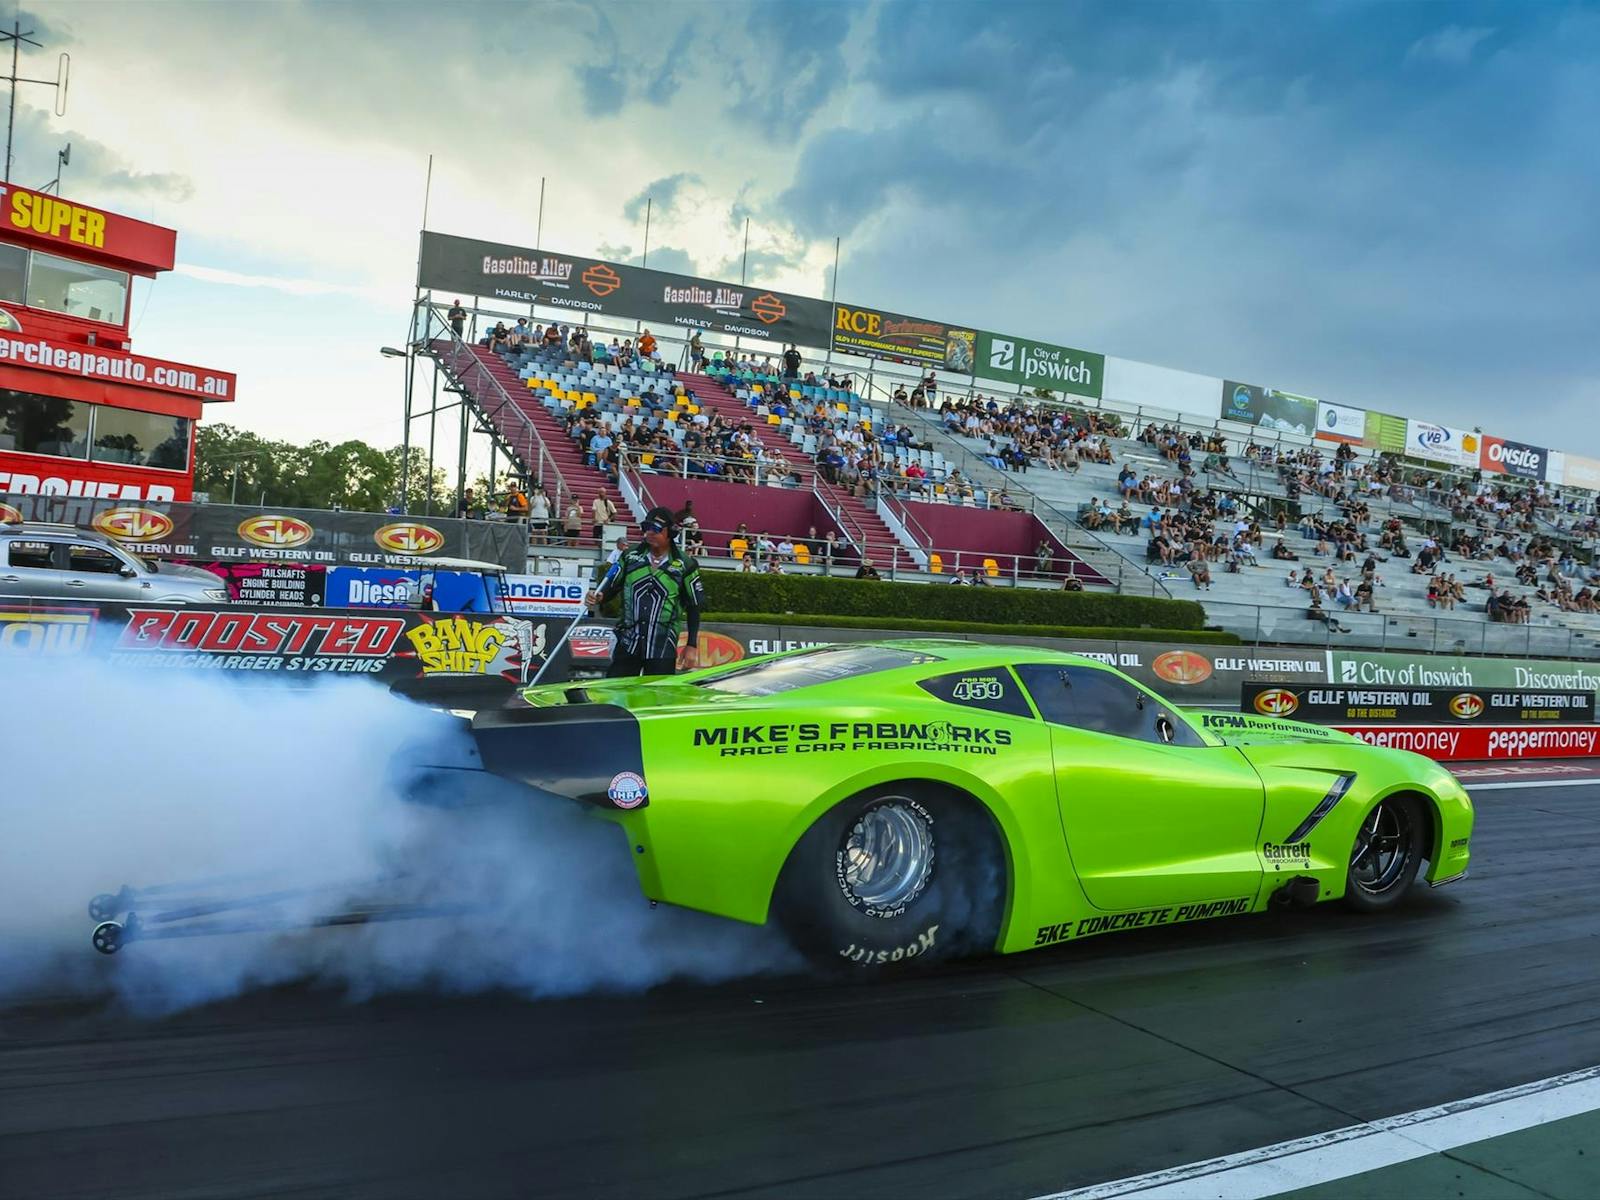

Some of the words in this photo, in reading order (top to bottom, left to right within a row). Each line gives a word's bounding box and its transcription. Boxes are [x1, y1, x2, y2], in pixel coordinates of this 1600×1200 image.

[10, 191, 106, 249] SUPER
[482, 256, 538, 275] Gasoline
[540, 258, 573, 280] Alley
[495, 288, 538, 301] HARLEY
[551, 297, 603, 311] DAVIDSON
[663, 286, 711, 304] Gasoline
[714, 288, 744, 309] Alley
[674, 316, 713, 328] HARLEY
[724, 324, 770, 338] DAVIDSON
[836, 307, 881, 336] RCE
[1033, 347, 1049, 361] City
[1051, 351, 1061, 361] of
[1020, 347, 1091, 385] Ipswich
[174, 544, 198, 556] OIL
[211, 546, 246, 558] GULF
[249, 548, 312, 560] WESTERN
[315, 551, 337, 562] OIL
[349, 552, 382, 564] GULF
[261, 568, 306, 579] TAILSHAFTS
[242, 578, 270, 589] ENGINE
[271, 580, 306, 590] BUILDING
[239, 589, 276, 600] CYLINDER
[279, 591, 305, 601] HEADS
[117, 608, 407, 657] BOOSTED
[406, 619, 504, 652] BANG
[285, 656, 387, 673] SYSTEMS
[421, 650, 496, 674] SHIFT
[1119, 653, 1144, 667] OIL
[1214, 657, 1246, 671] GULF
[1248, 659, 1306, 673] WESTERN
[1306, 661, 1324, 674] OIL
[1360, 661, 1396, 684] City
[1398, 664, 1416, 684] of
[1419, 664, 1473, 686] Ipswich
[952, 682, 1003, 701] 459
[1308, 690, 1345, 705] GULF
[1347, 691, 1409, 705] WESTERN
[1411, 692, 1433, 706] OIL
[1490, 694, 1520, 707] GULF
[1521, 695, 1570, 708] WESTERN
[1571, 696, 1589, 708] OIL
[693, 723, 821, 747] MIKE'S
[1202, 714, 1248, 729] KPM
[1248, 719, 1329, 737] Performance
[719, 745, 788, 757] RACE
[795, 742, 846, 753] CAR
[852, 741, 997, 755] FABRICATION
[1487, 730, 1597, 757] peppermoney
[612, 790, 643, 801] IHRA
[910, 801, 934, 825] USA
[1263, 841, 1311, 859] Garrett
[836, 851, 862, 906] RACING
[865, 907, 905, 919] WELD
[1034, 921, 1073, 946] SKE
[1075, 907, 1171, 937] CONCRETE
[1174, 896, 1251, 922] PUMPING
